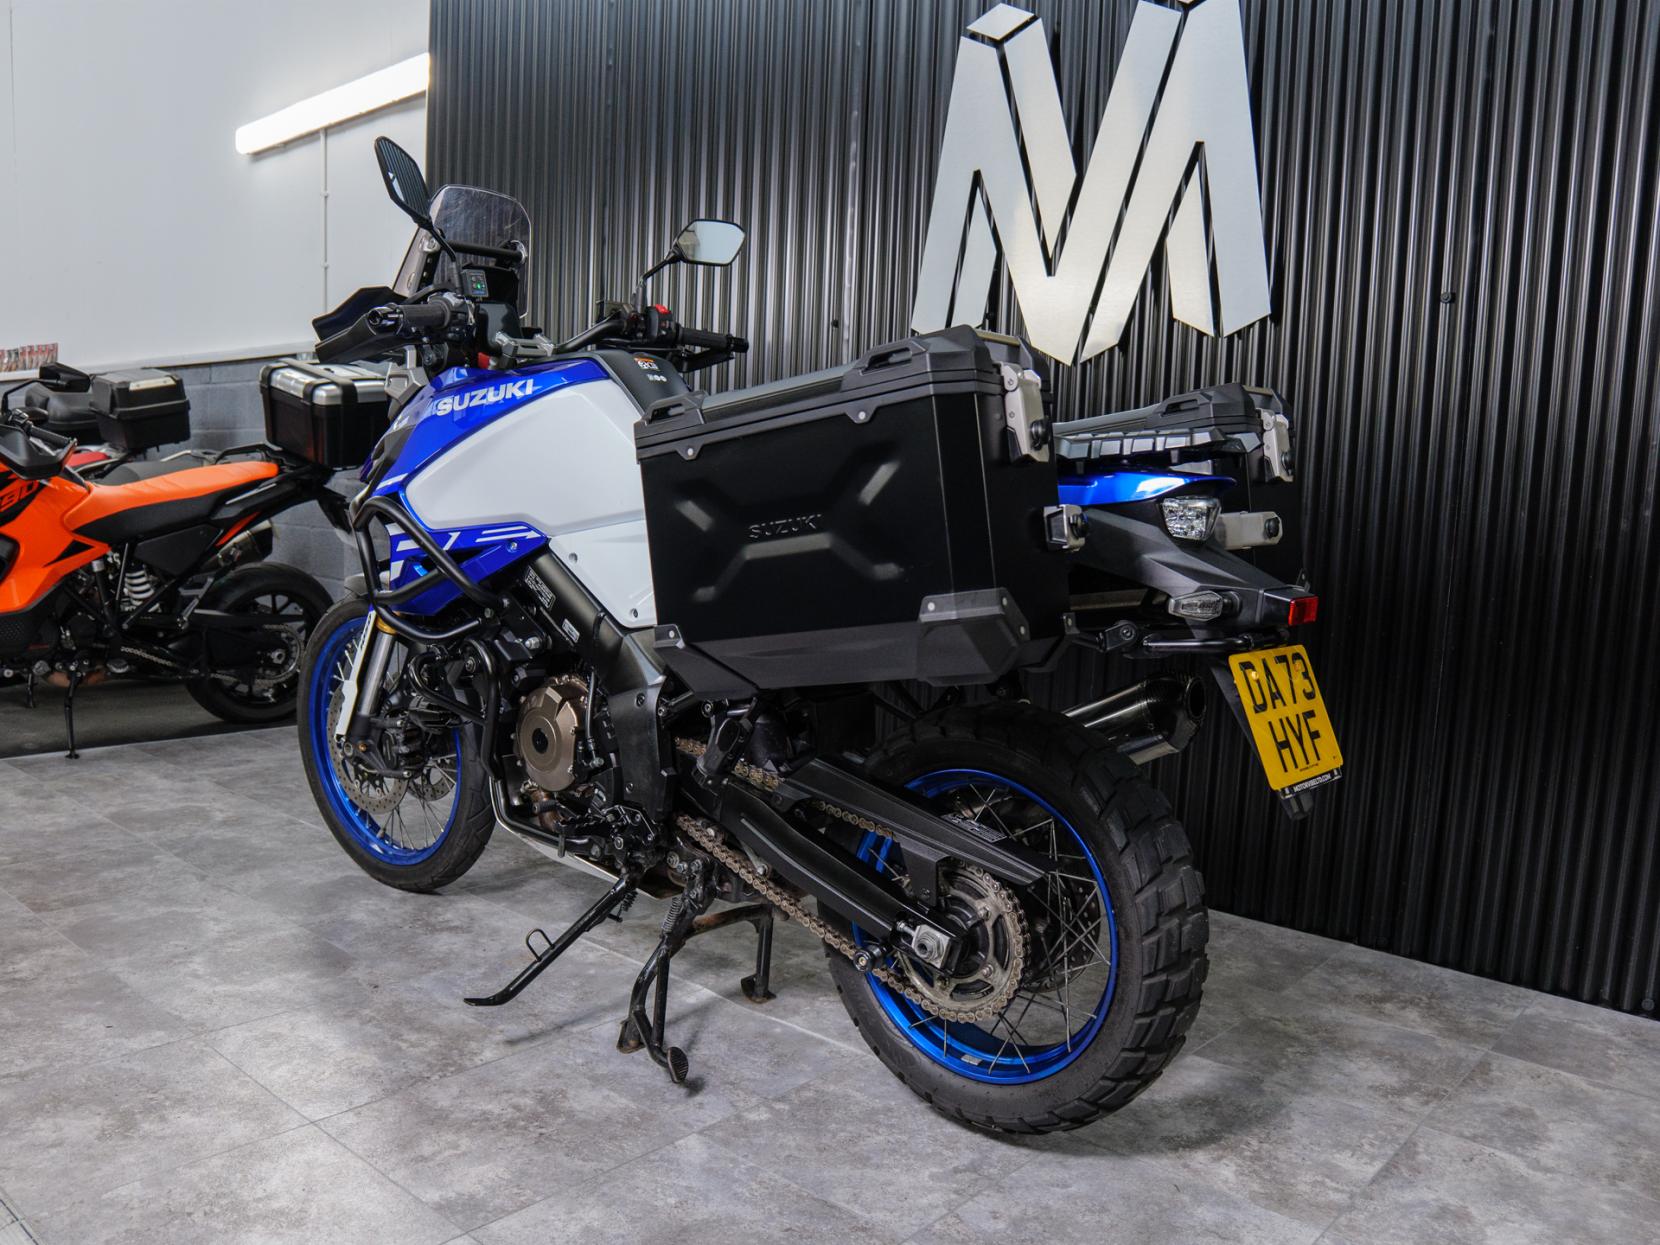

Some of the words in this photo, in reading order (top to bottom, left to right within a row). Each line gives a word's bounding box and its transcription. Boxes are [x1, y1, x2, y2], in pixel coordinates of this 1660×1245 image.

[436, 378, 534, 416] SUZUKI
[748, 513, 822, 539] SUZUKI
[1238, 652, 1316, 714] DA73
[1267, 709, 1321, 773] HYF
